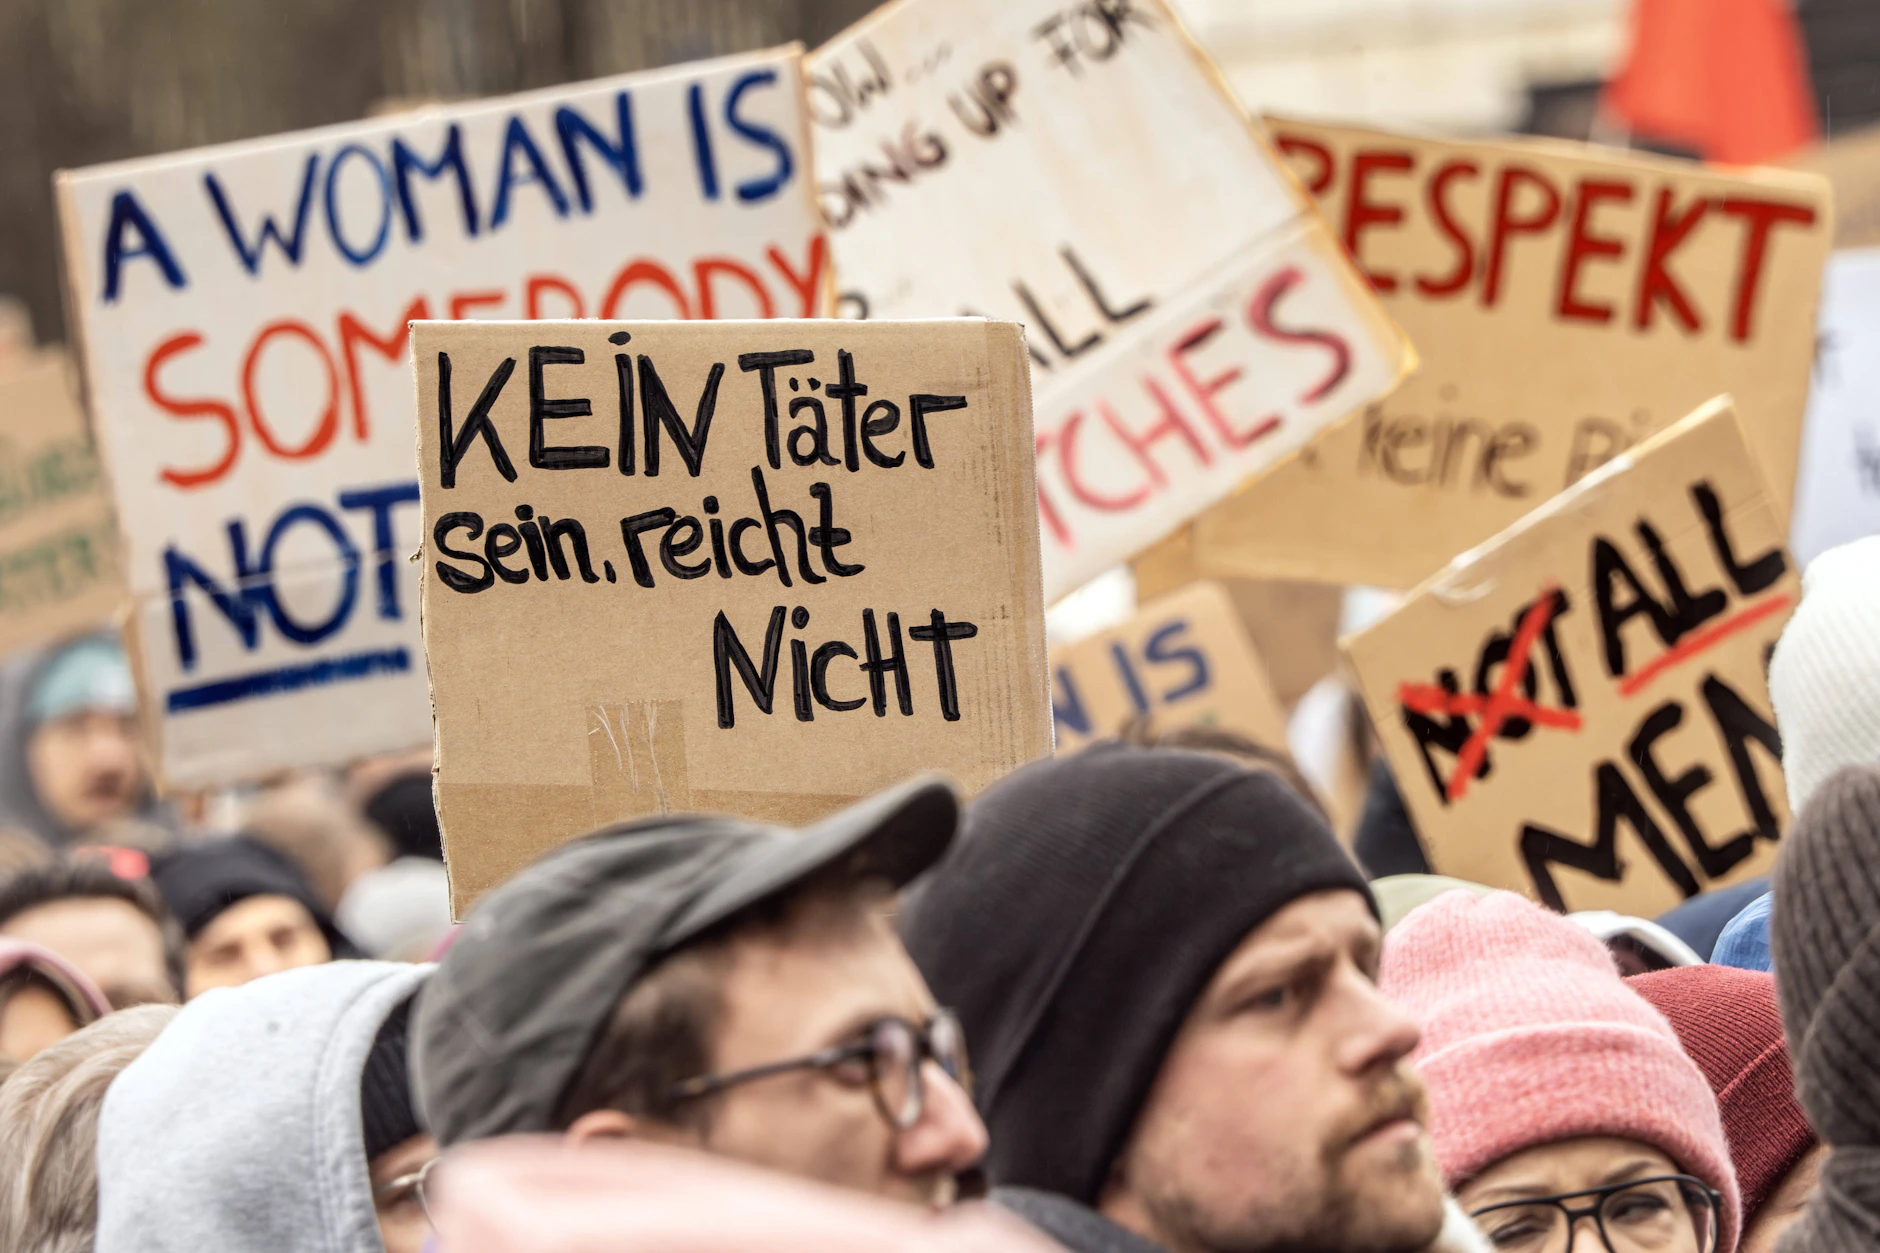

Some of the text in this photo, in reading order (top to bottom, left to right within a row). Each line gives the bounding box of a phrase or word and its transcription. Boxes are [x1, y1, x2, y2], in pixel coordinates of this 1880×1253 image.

[945, 55, 1018, 142] UP
[101, 70, 796, 301] A WOMAN IS
[142, 235, 830, 487] SOMY
[1012, 242, 1158, 366] LL
[738, 349, 968, 473] Täter
[162, 482, 420, 676] NOT
[620, 466, 866, 588] reicht
[1108, 618, 1214, 718] IS
[1402, 476, 1788, 806] NOT ALL
